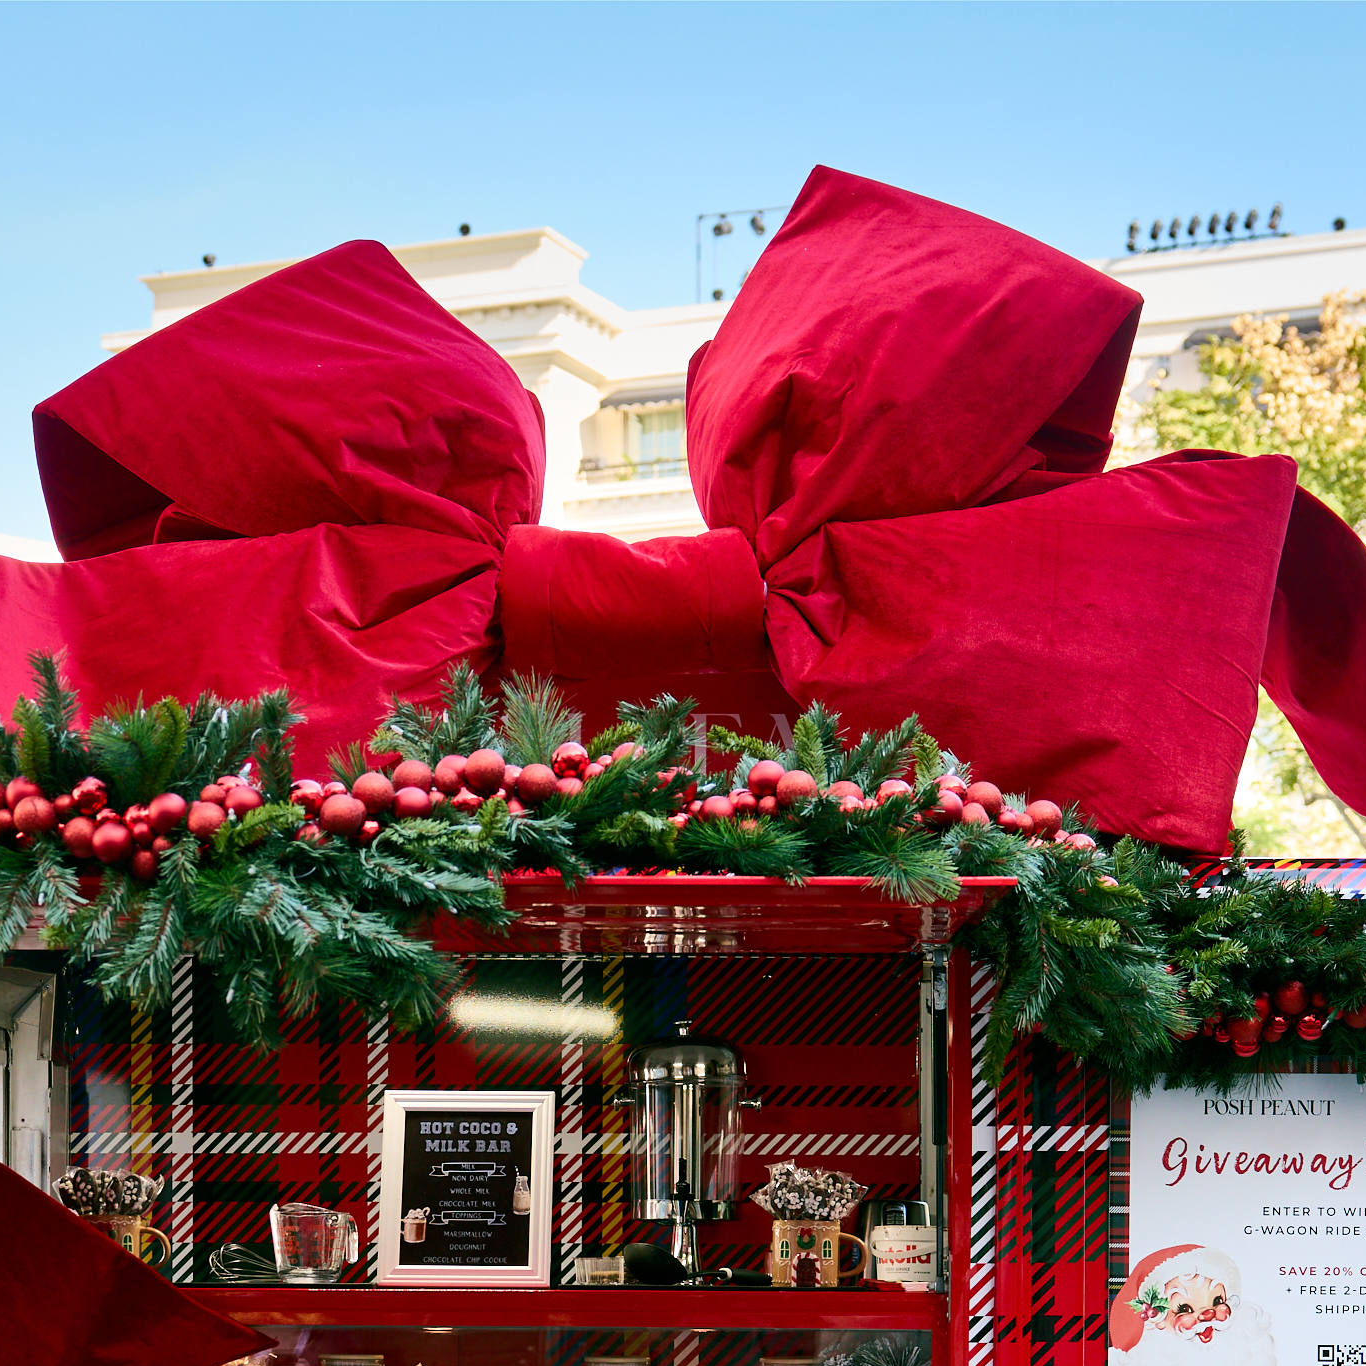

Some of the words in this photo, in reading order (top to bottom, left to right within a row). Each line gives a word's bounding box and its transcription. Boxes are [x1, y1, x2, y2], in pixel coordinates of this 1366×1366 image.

[1203, 1098, 1254, 1117] POSH
[1260, 1098, 1336, 1117] PEANUT
[420, 1121, 455, 1135] HOT
[459, 1121, 502, 1135] COCO
[506, 1121, 519, 1135] &
[425, 1139, 470, 1153] MILK
[475, 1139, 512, 1153] BAR
[439, 1200, 479, 1208] CHOCOLATE
[482, 1200, 497, 1208] MILK
[1262, 1206, 1311, 1217] ENTER
[1318, 1206, 1337, 1217] TO
[1243, 1225, 1319, 1236] G-WAGON
[1325, 1225, 1361, 1236] RIDE
[1278, 1266, 1317, 1277] SAVE
[1323, 1266, 1354, 1277] 20%
[1299, 1285, 1337, 1296] FREE
